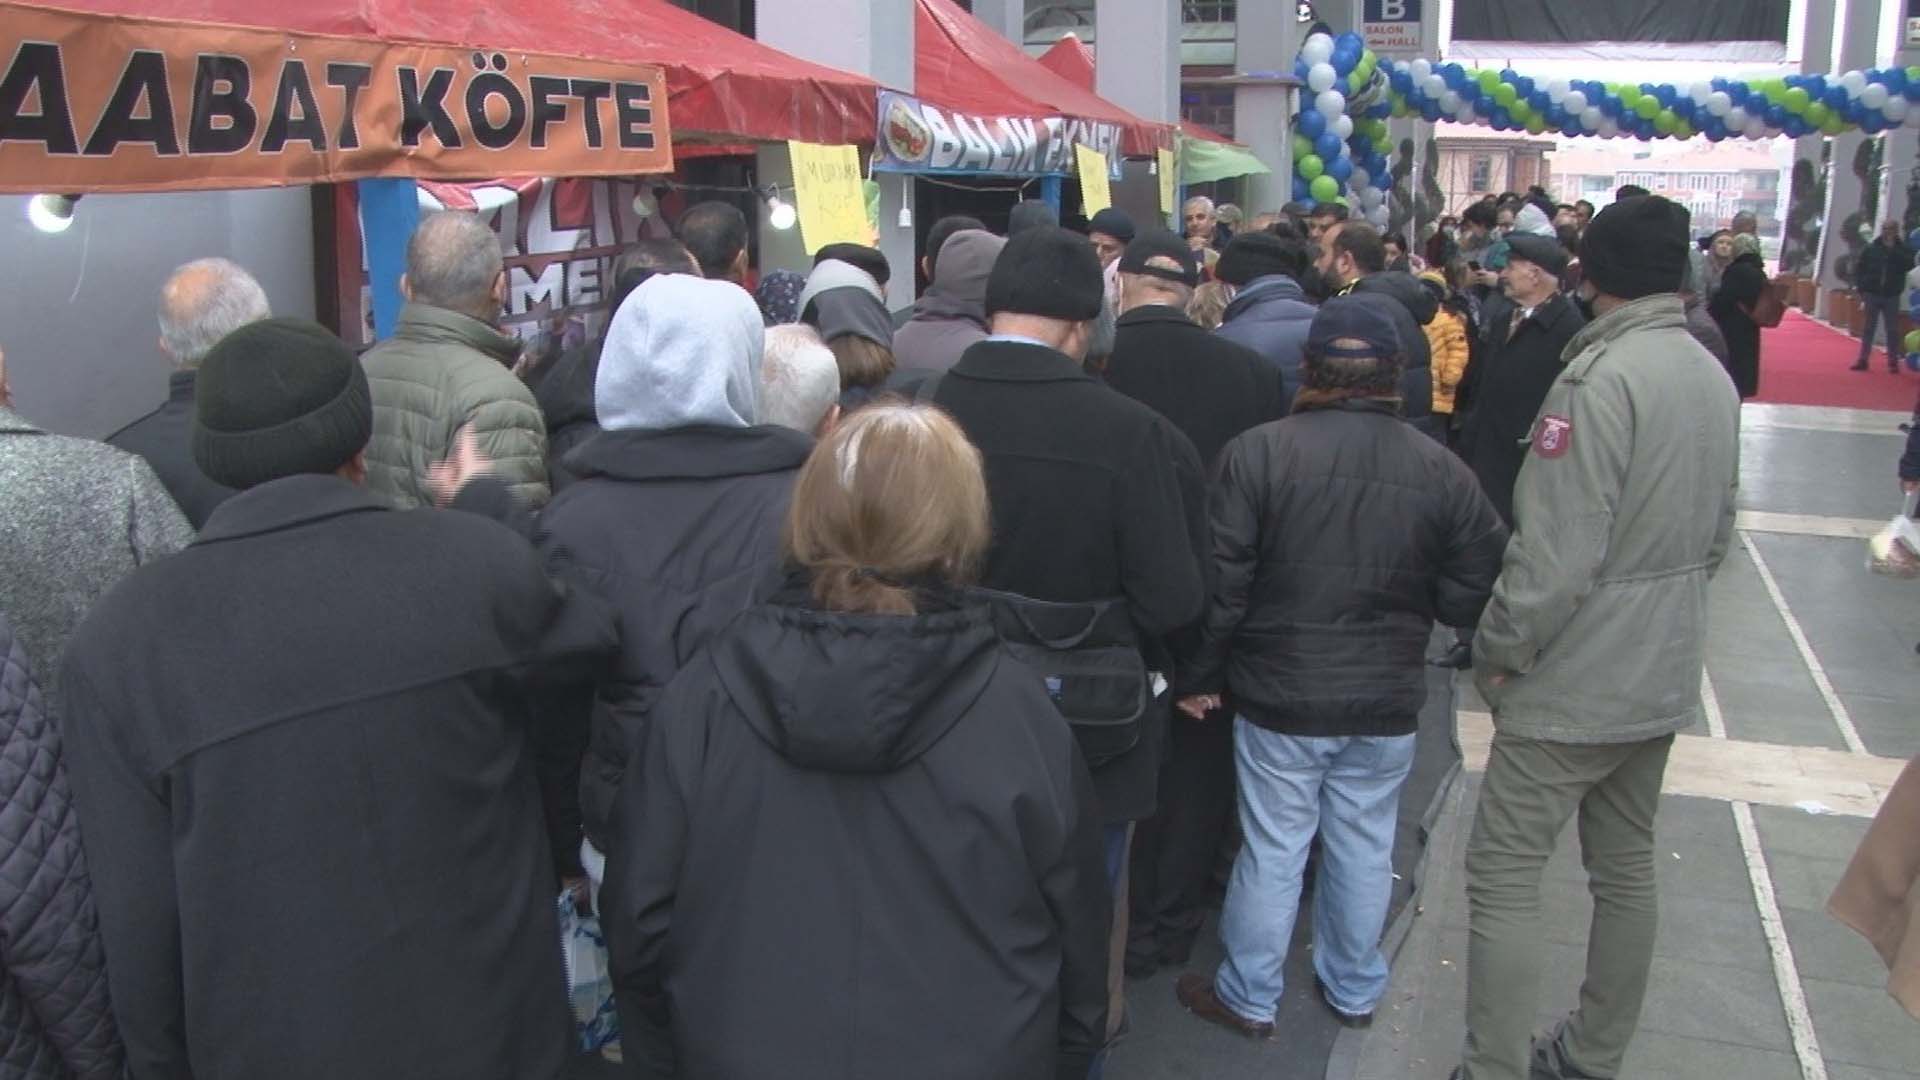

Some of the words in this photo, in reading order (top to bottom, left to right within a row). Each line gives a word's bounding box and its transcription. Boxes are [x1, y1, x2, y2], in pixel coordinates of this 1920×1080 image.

[1366, 25, 1404, 34] SALON
[1387, 37, 1417, 46] HALL
[397, 51, 655, 150] KÖFTE
